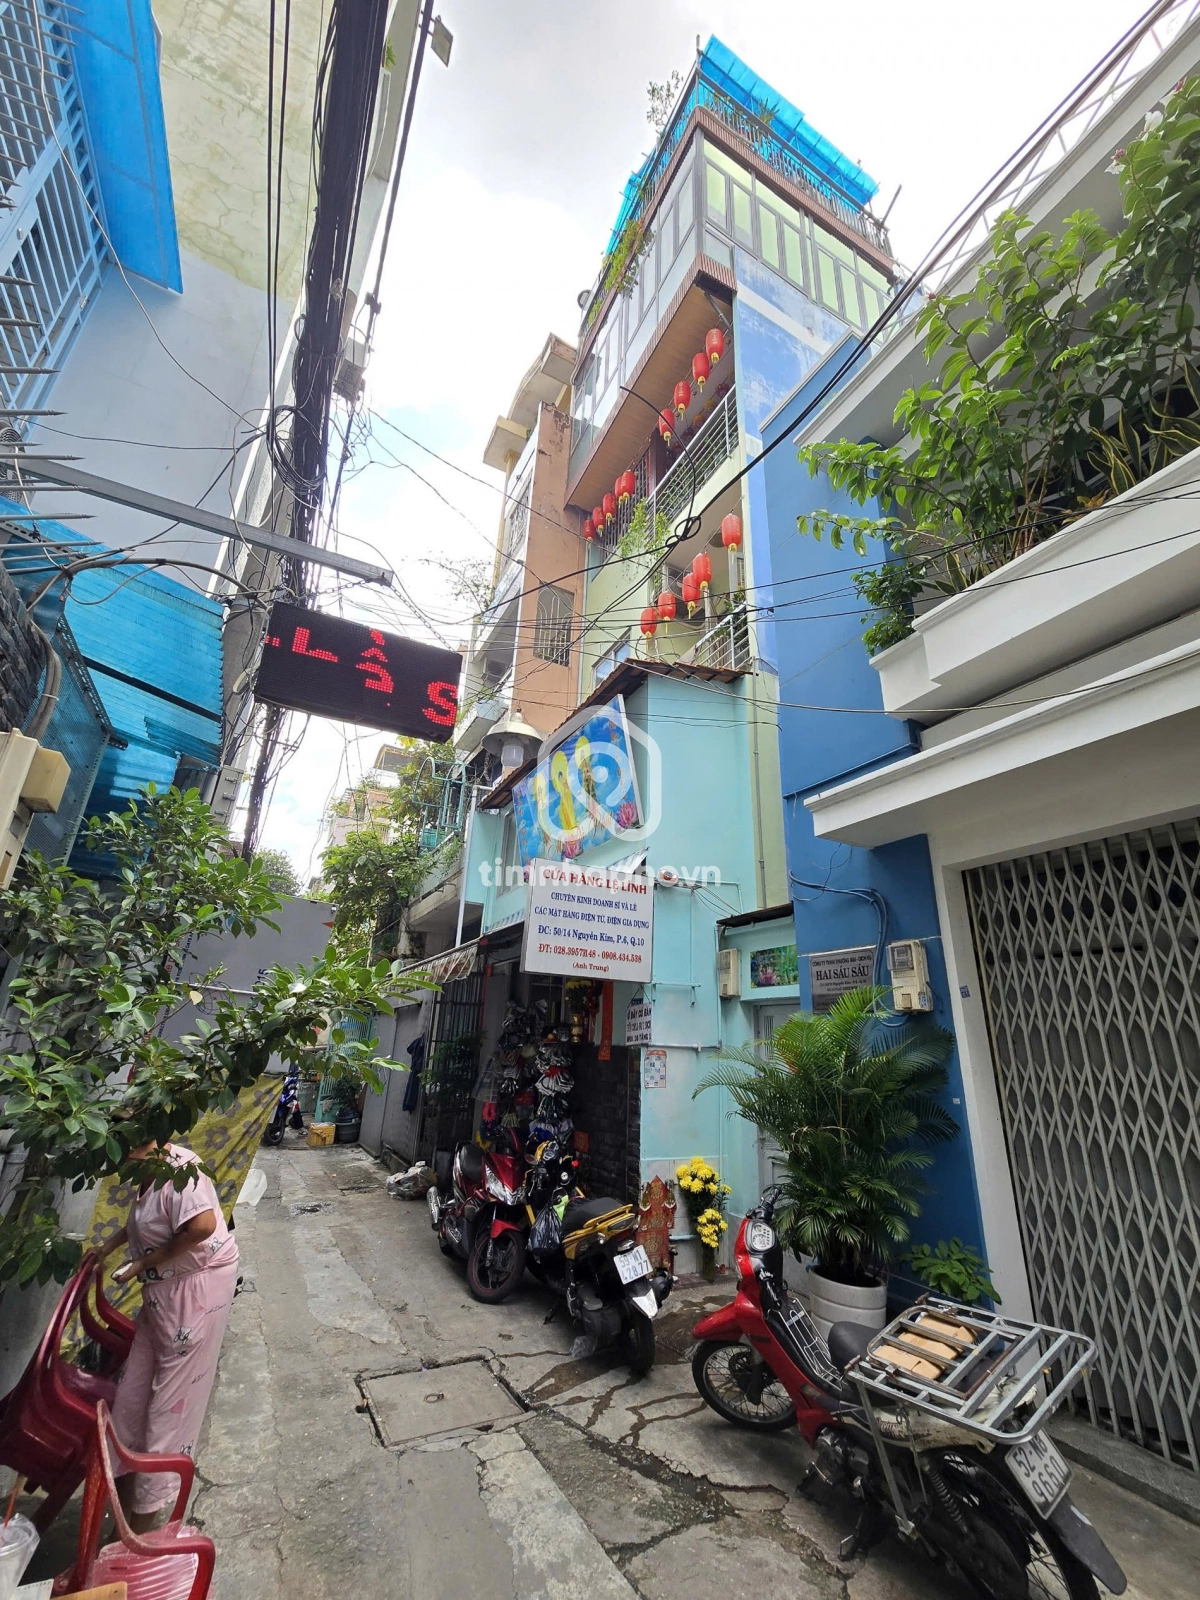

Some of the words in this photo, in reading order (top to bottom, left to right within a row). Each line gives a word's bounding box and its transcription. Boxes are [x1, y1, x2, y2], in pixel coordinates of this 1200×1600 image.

[542, 868, 567, 881] CỬA
[570, 872, 603, 888] HÀNG
[551, 892, 576, 903] CHUYÊN
[577, 896, 592, 905] KINH
[593, 898, 614, 908] DOANH
[621, 901, 629, 911] VÀ
[534, 906, 548, 916] CÁC
[562, 909, 580, 920] HÀNG
[581, 912, 596, 922] ĐIỆN
[607, 915, 622, 926] ĐIỆN
[622, 918, 633, 927] GIA
[633, 920, 650, 929] DỤNG
[538, 924, 552, 935] ĐC:
[553, 927, 571, 938] 50/14
[599, 932, 615, 944] Kim,
[630, 936, 645, 947] Q.10
[538, 943, 552, 954] ĐT:
[588, 963, 610, 972] Trung)
[816, 969, 832, 980] HAI
[832, 965, 850, 979] SÁU
[851, 963, 870, 978] SÁU
[1031, 1455, 1068, 1503] 9660
